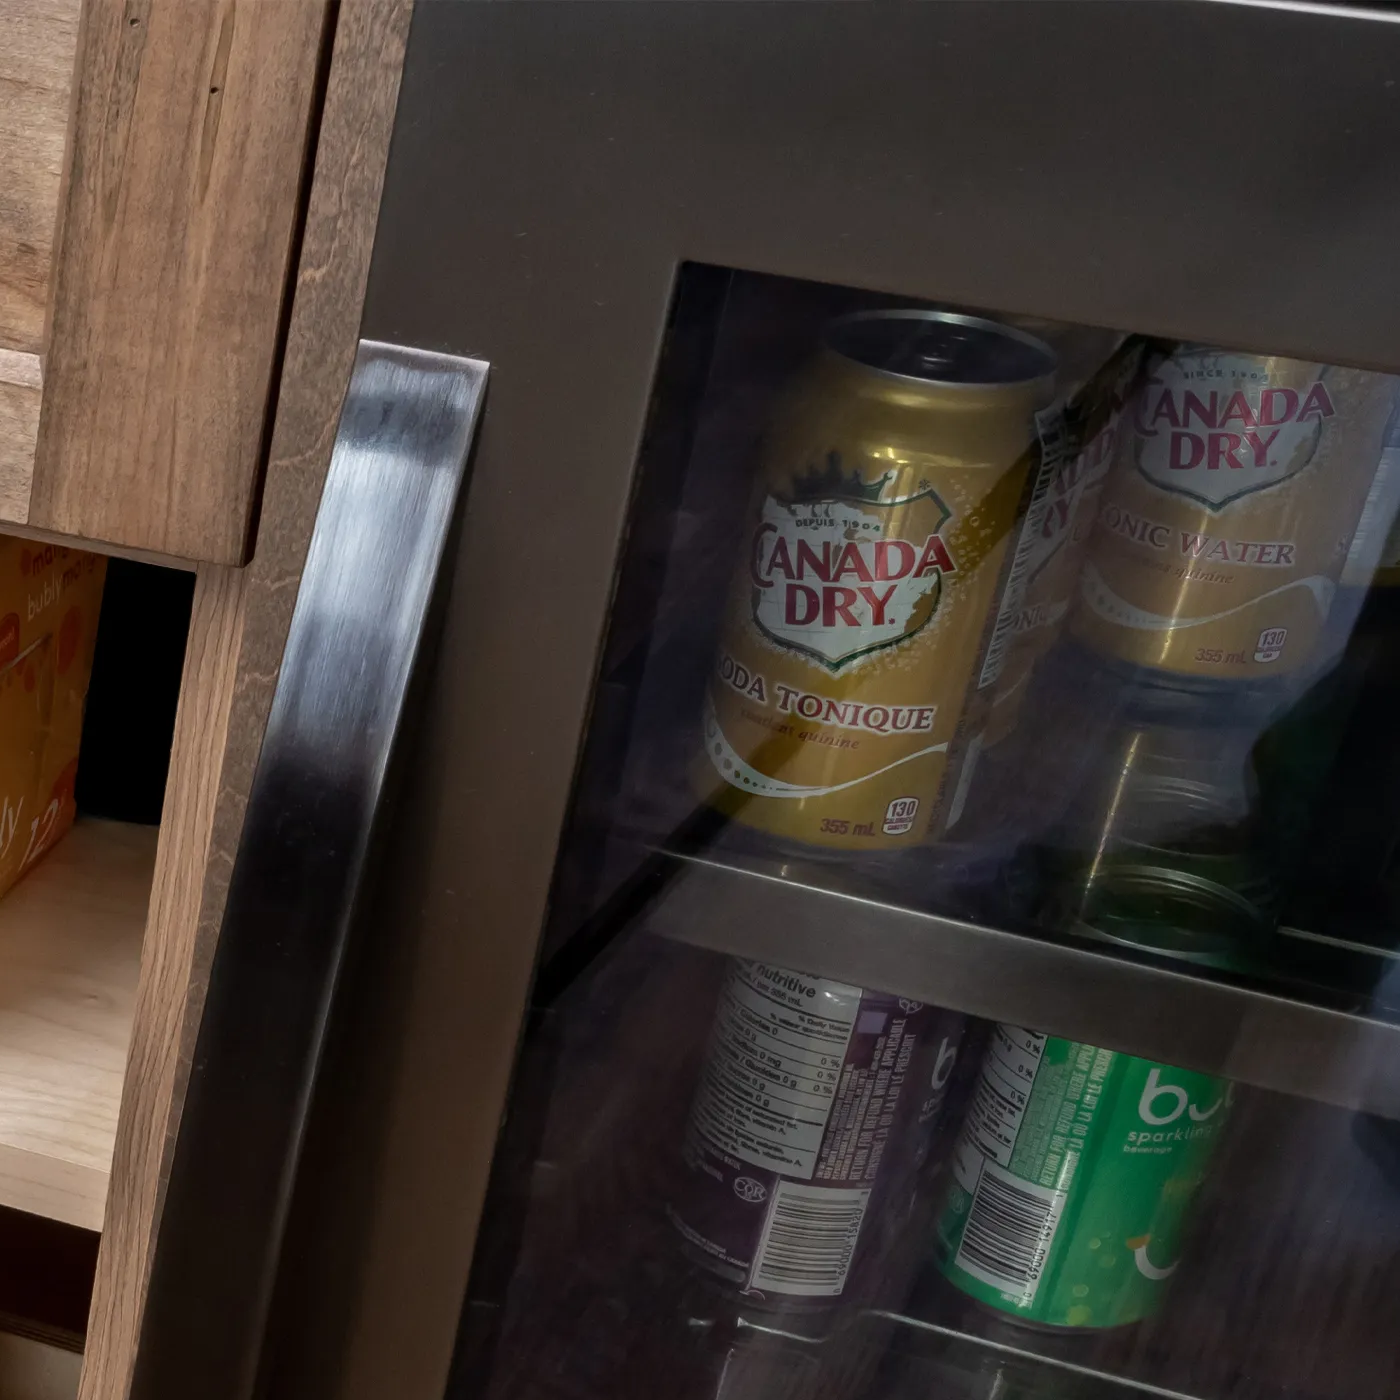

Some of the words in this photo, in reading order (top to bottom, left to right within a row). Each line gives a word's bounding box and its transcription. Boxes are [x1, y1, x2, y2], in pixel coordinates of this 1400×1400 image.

[1133, 381, 1334, 437] CANADA
[1104, 510, 1169, 548] ONIC
[1180, 532, 1296, 565] WATER
[751, 522, 957, 588] CANADA
[1262, 630, 1285, 646] 130
[777, 686, 936, 732] TONIQUE
[798, 731, 860, 750] quinine
[892, 800, 917, 817] 130
[820, 818, 848, 835] 355
[756, 964, 816, 998] nutritive
[881, 1018, 908, 1066] APPLICABLE
[872, 1068, 892, 1096] WHERE
[1018, 1064, 1024, 1073] 0
[1063, 1070, 1086, 1100] WHERE
[862, 1097, 883, 1129] REFUND
[1053, 1101, 1077, 1133] REFUND
[1026, 1247, 1046, 1280] 69000
[1038, 1212, 1057, 1242] 14917
